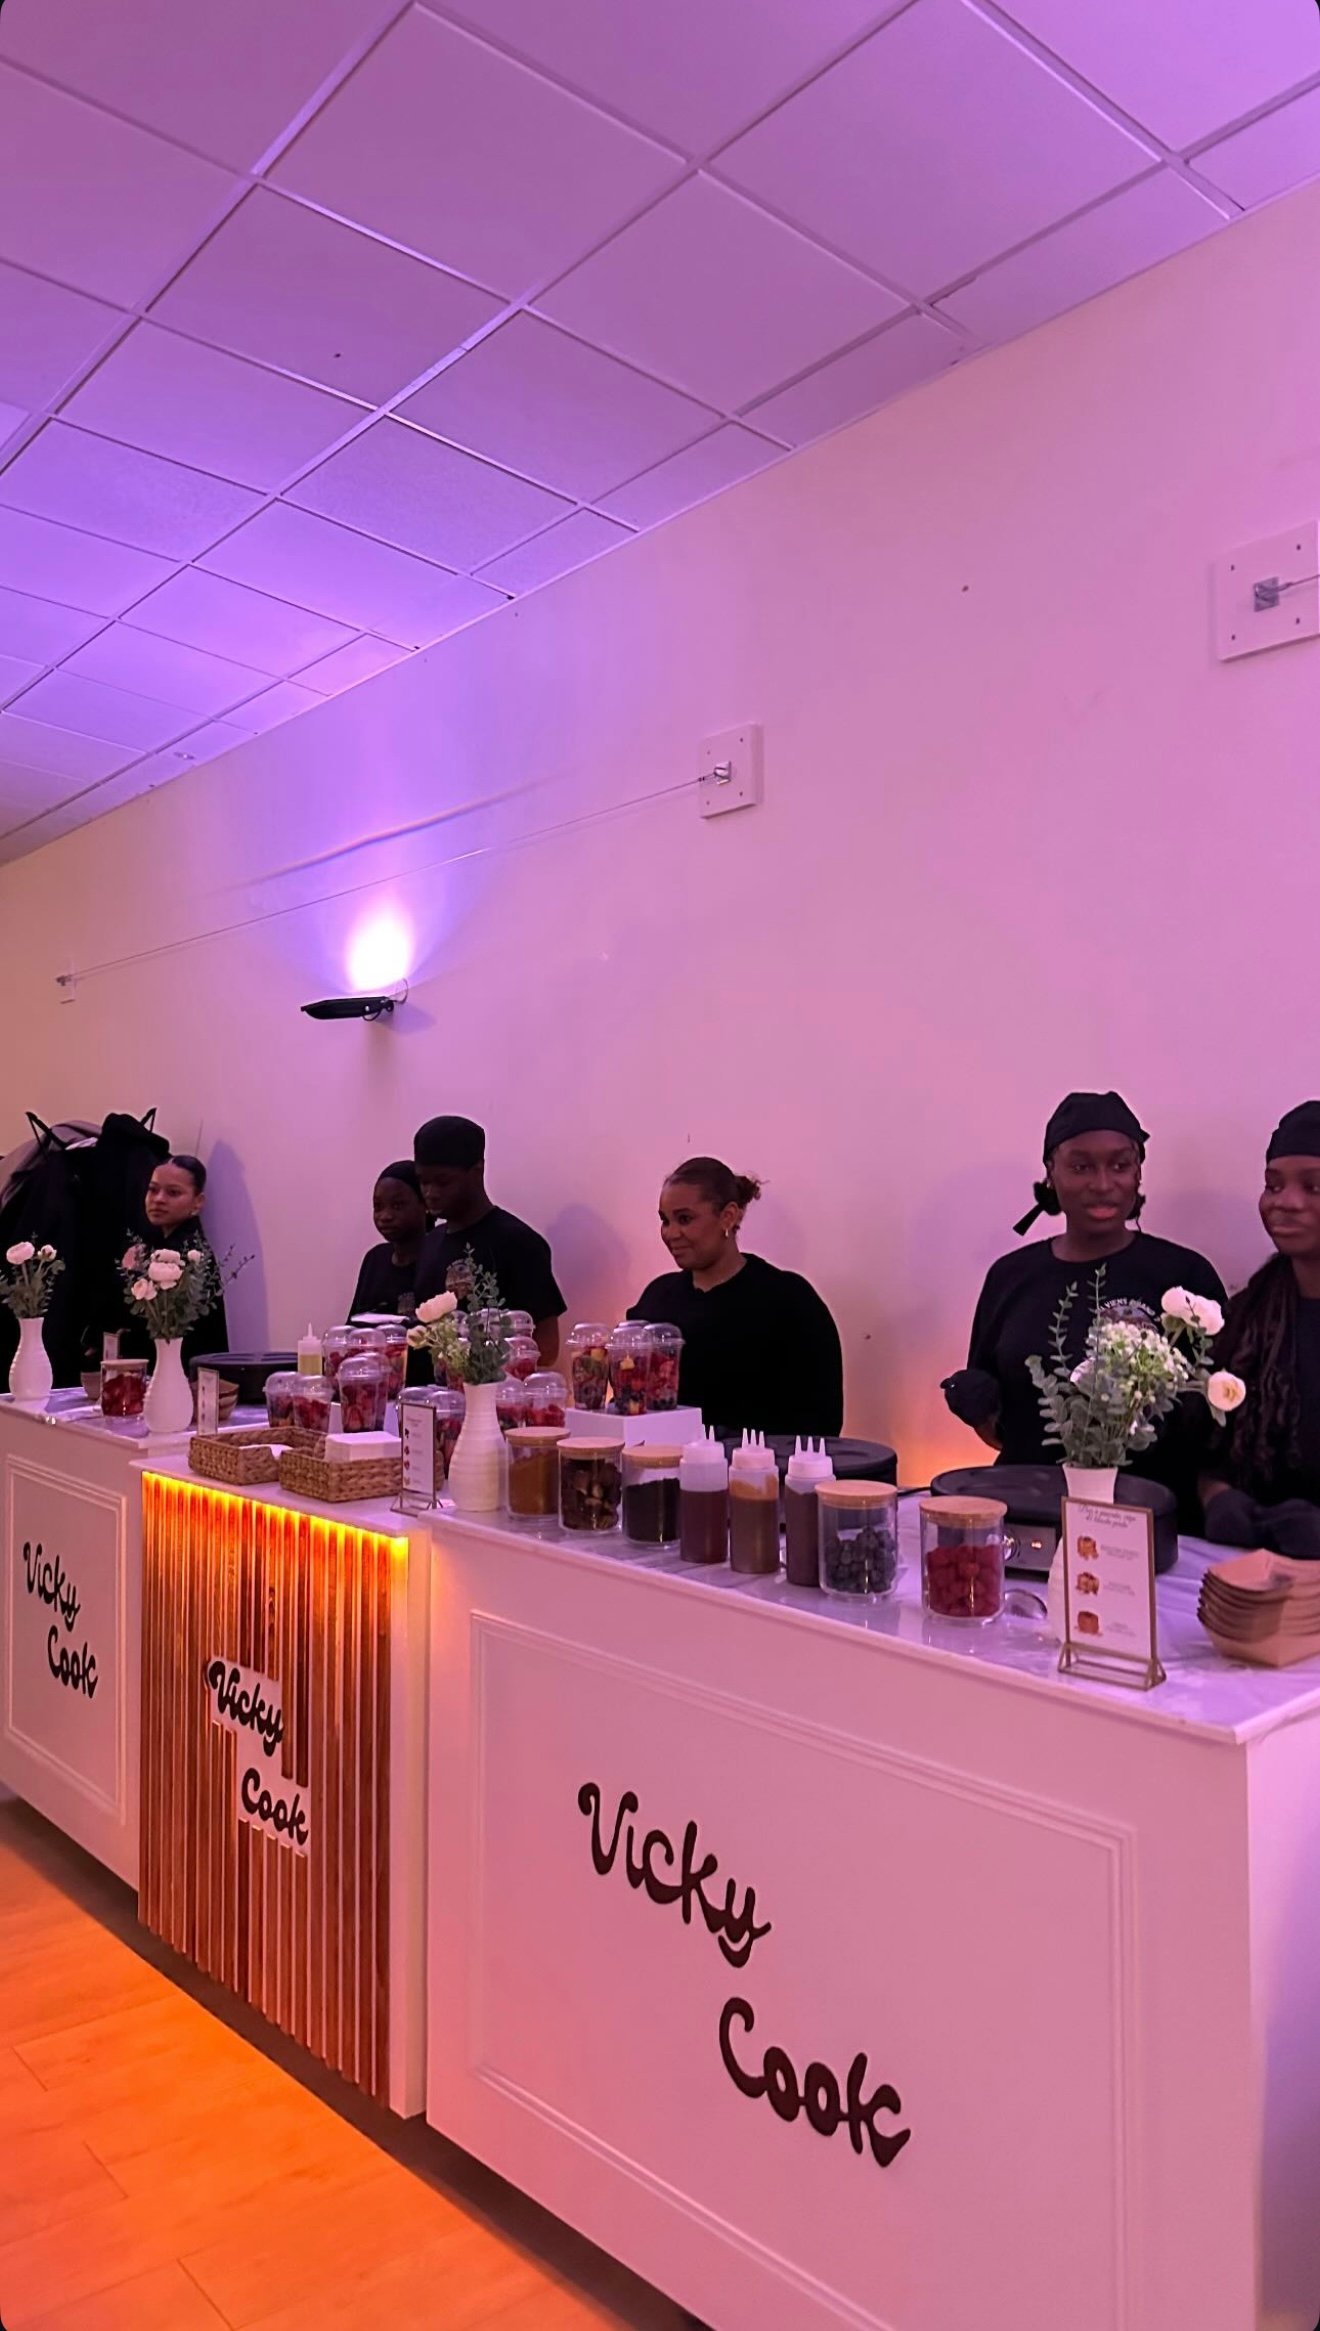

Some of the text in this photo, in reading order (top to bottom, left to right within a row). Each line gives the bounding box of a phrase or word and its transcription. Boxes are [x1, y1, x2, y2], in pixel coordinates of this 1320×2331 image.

[23, 1541, 81, 1632] Vicky
[48, 1625, 99, 1699] Cook
[207, 1660, 284, 1757] Vicky
[241, 1767, 309, 1846] Cook
[577, 1782, 772, 1969] Vicky
[718, 1996, 912, 2169] Cook
